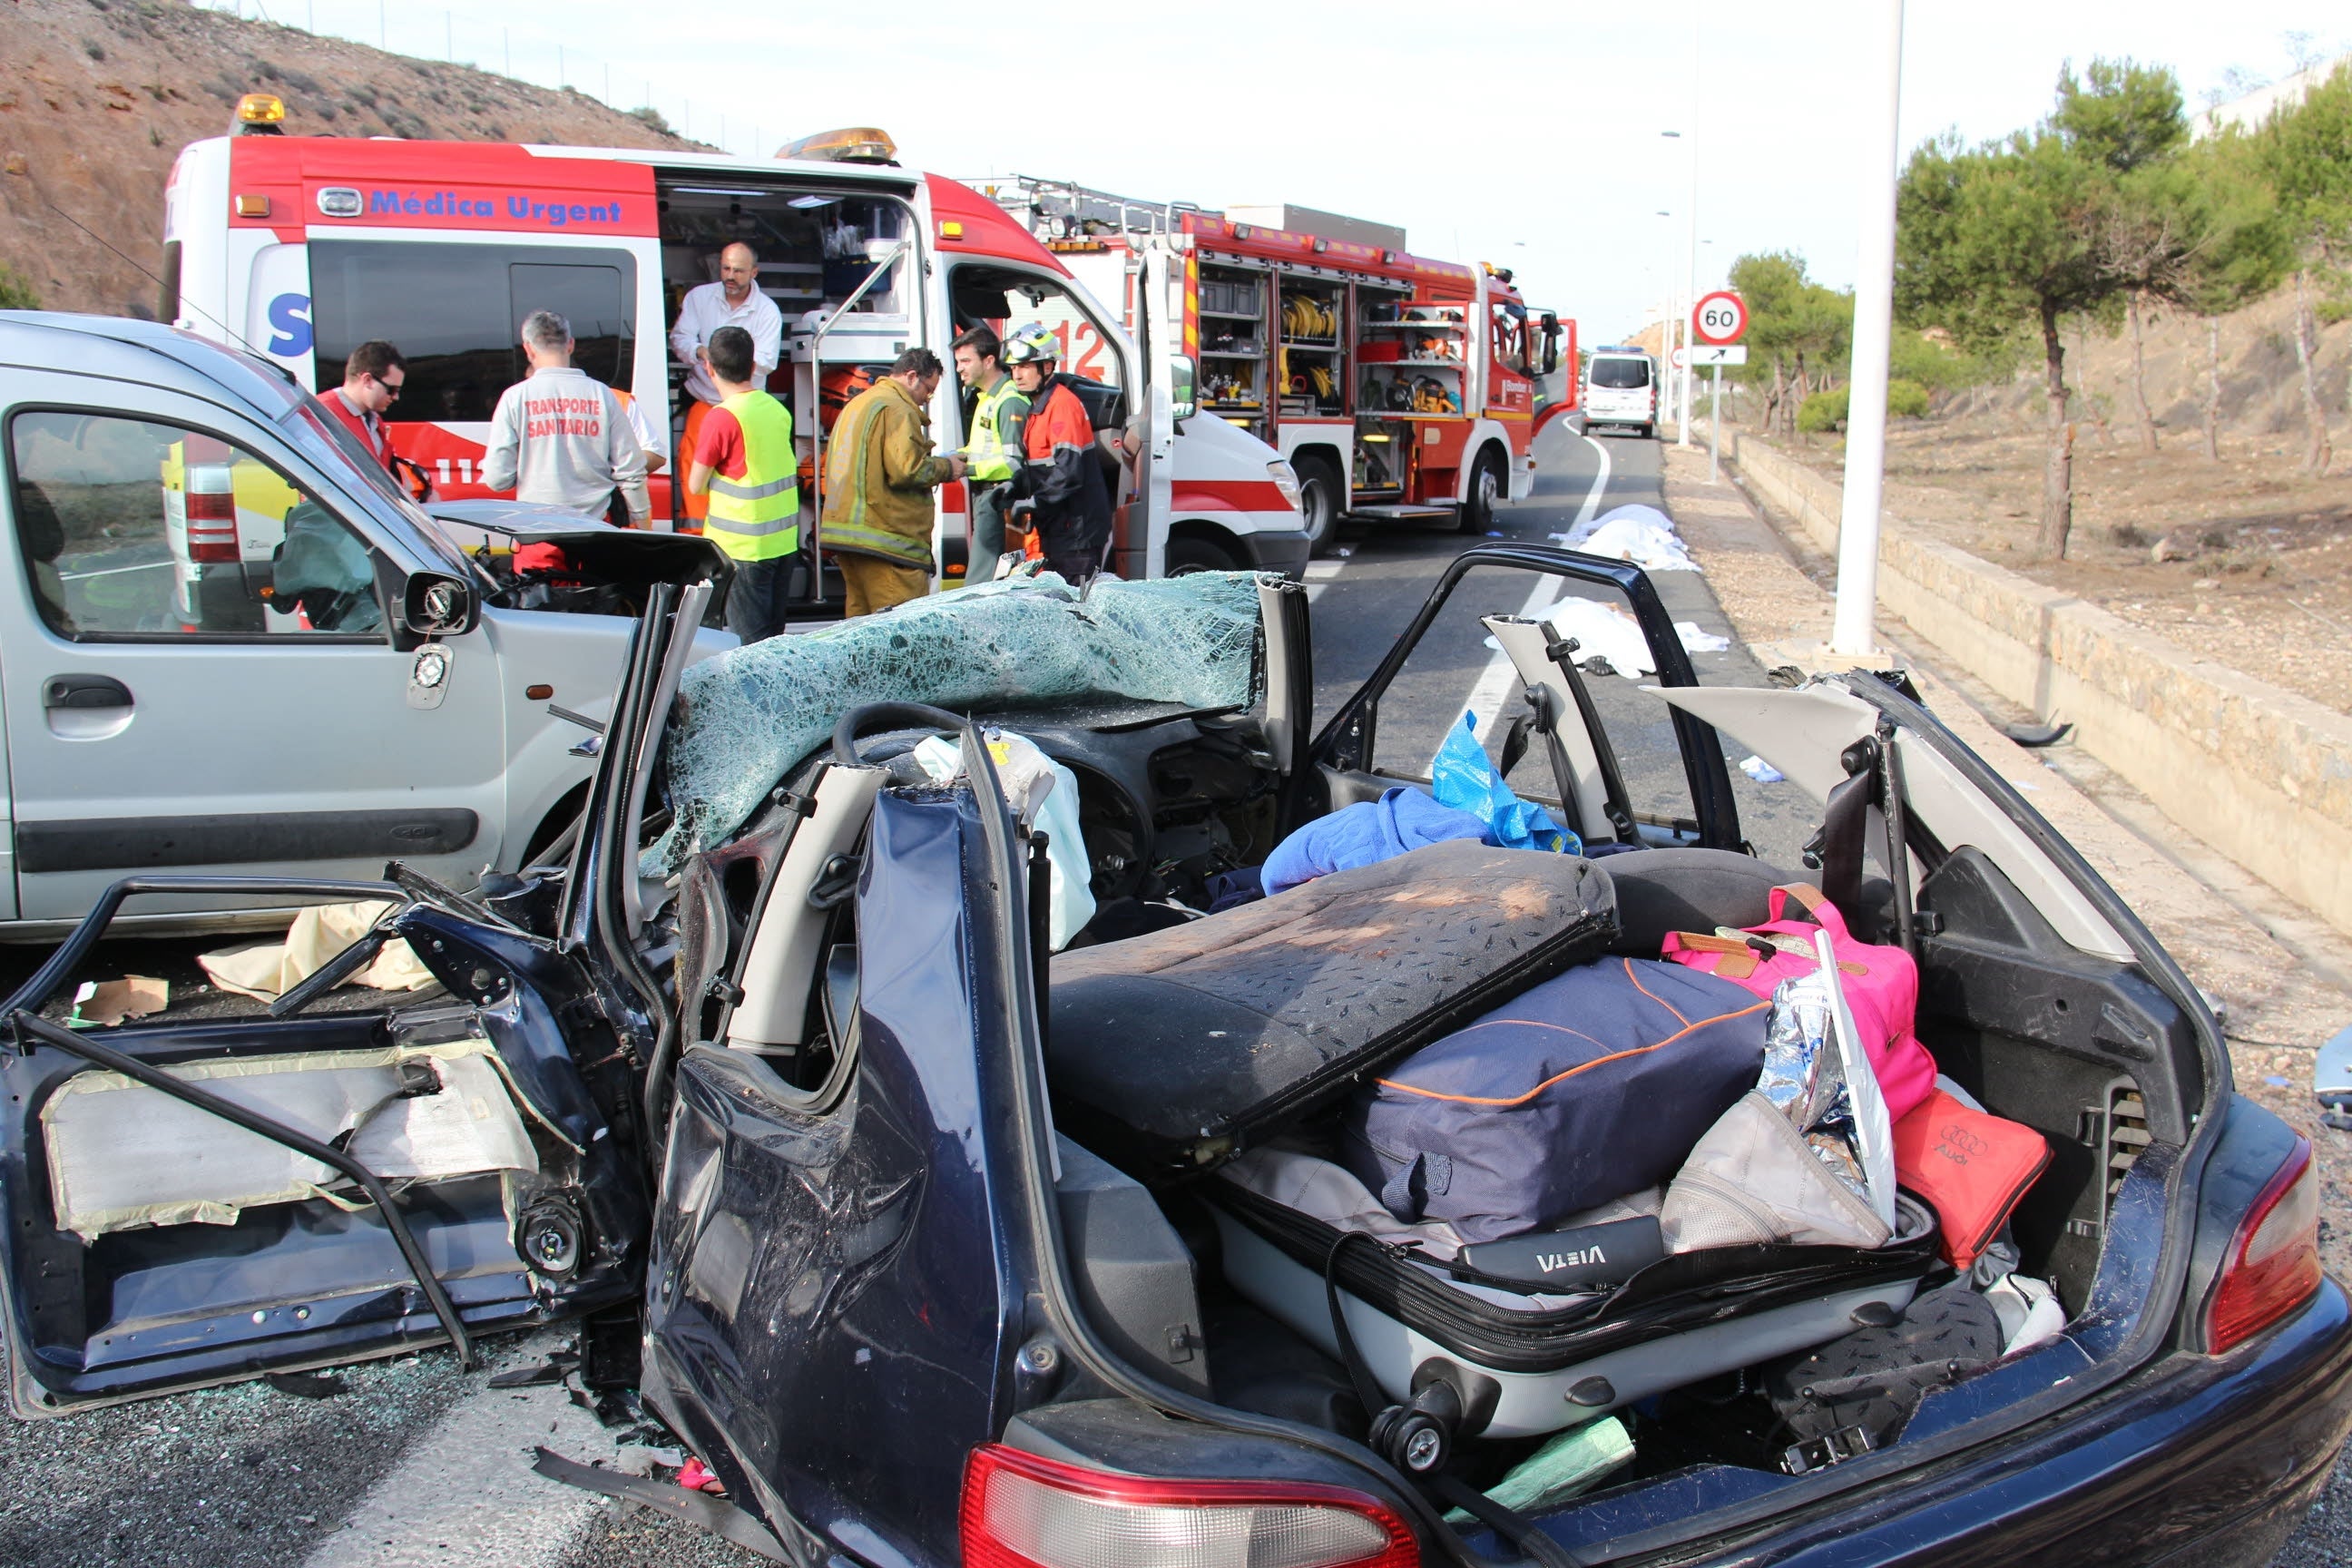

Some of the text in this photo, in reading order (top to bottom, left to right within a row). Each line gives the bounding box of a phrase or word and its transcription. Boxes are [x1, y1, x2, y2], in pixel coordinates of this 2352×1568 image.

[370, 191, 622, 226] Médica Urgent
[1706, 309, 1734, 327] 60
[524, 398, 600, 416] TRANSPORTE
[528, 418, 599, 438] SANITARIO
[1934, 1143, 1968, 1165] Audi
[1536, 1245, 1606, 1272] VIETA
